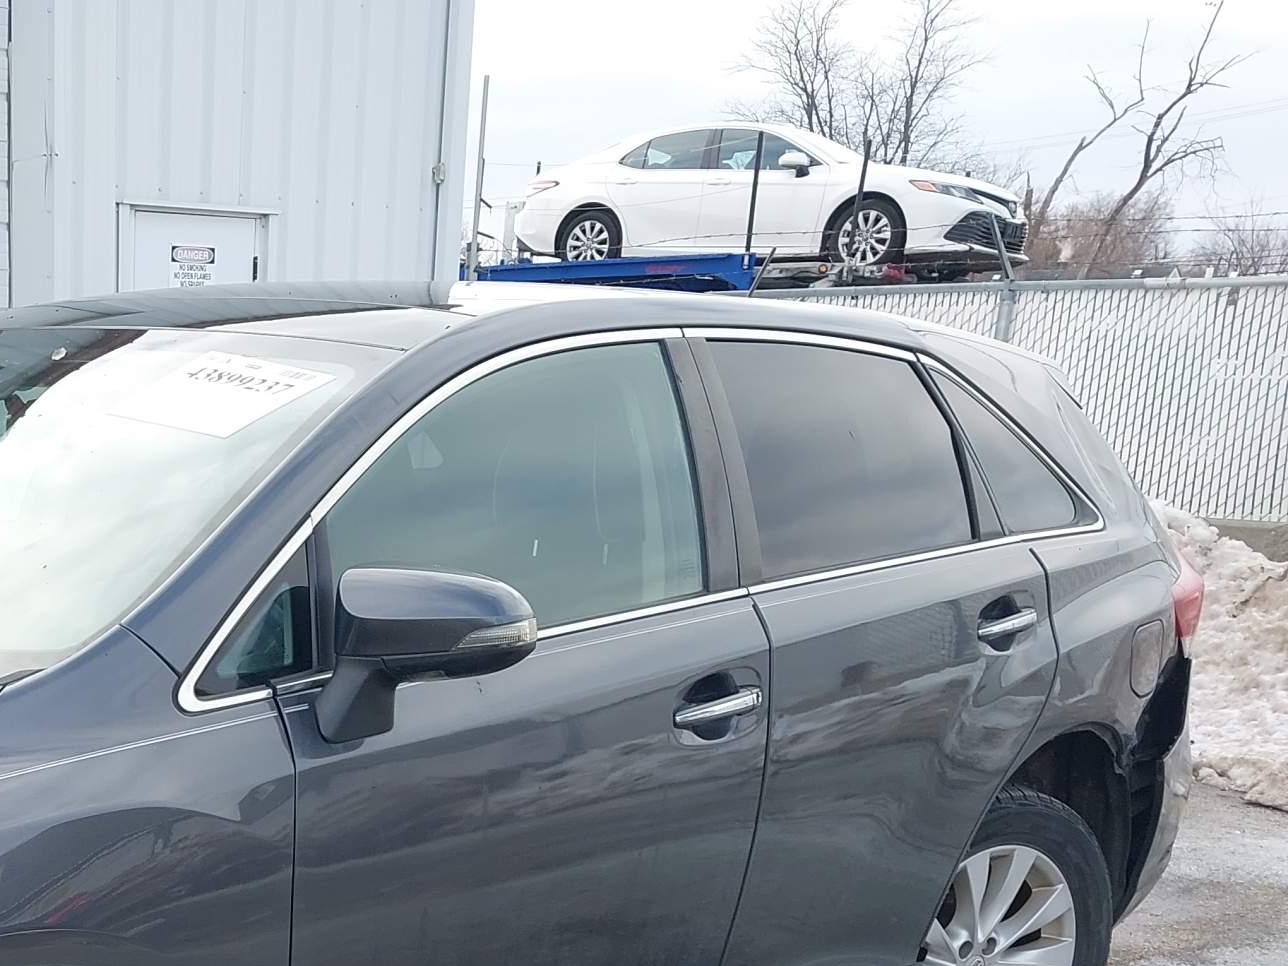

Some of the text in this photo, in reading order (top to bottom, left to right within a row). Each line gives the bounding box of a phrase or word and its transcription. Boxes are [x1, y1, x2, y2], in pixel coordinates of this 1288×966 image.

[177, 249, 209, 260] DANGER
[187, 264, 207, 272] SMOKING
[181, 272, 193, 280] OPEN
[194, 272, 212, 280] FLAMES
[186, 367, 295, 394] 43899237
